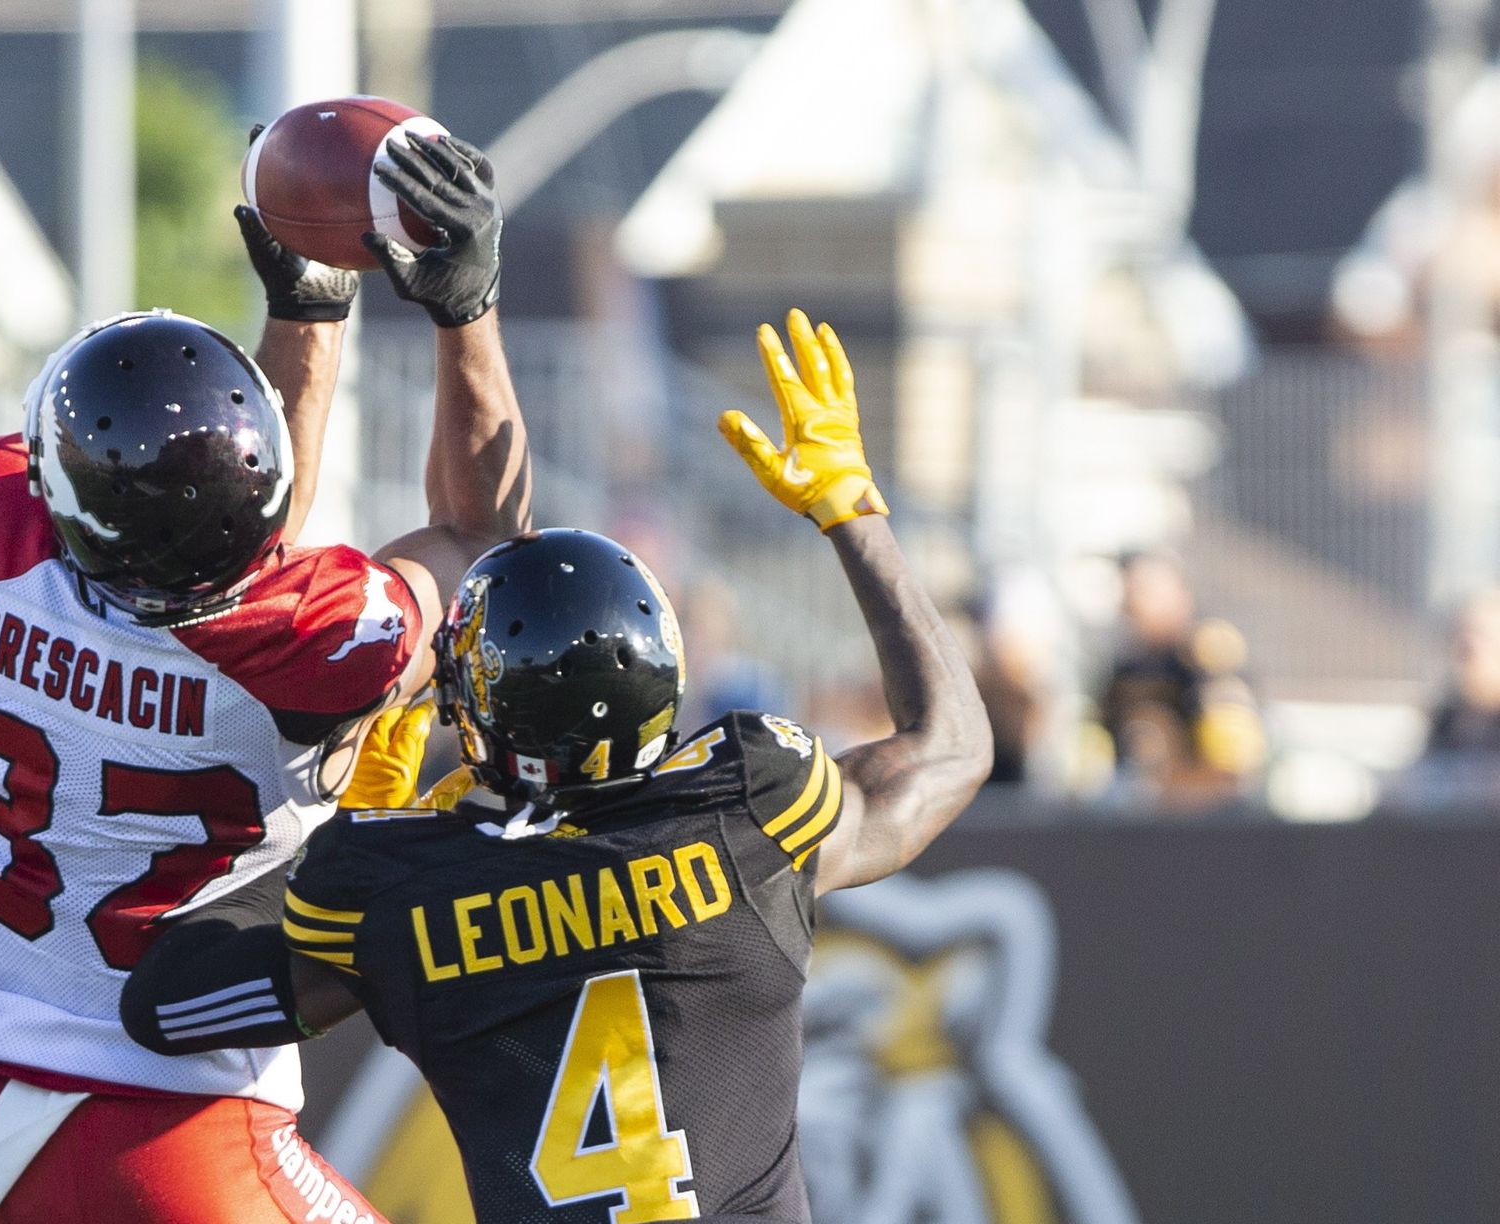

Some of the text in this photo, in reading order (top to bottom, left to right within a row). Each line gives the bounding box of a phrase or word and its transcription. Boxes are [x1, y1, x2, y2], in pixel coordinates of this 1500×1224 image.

[581, 740, 613, 781] 4
[651, 726, 727, 777] 4
[411, 841, 733, 982] LEONARD
